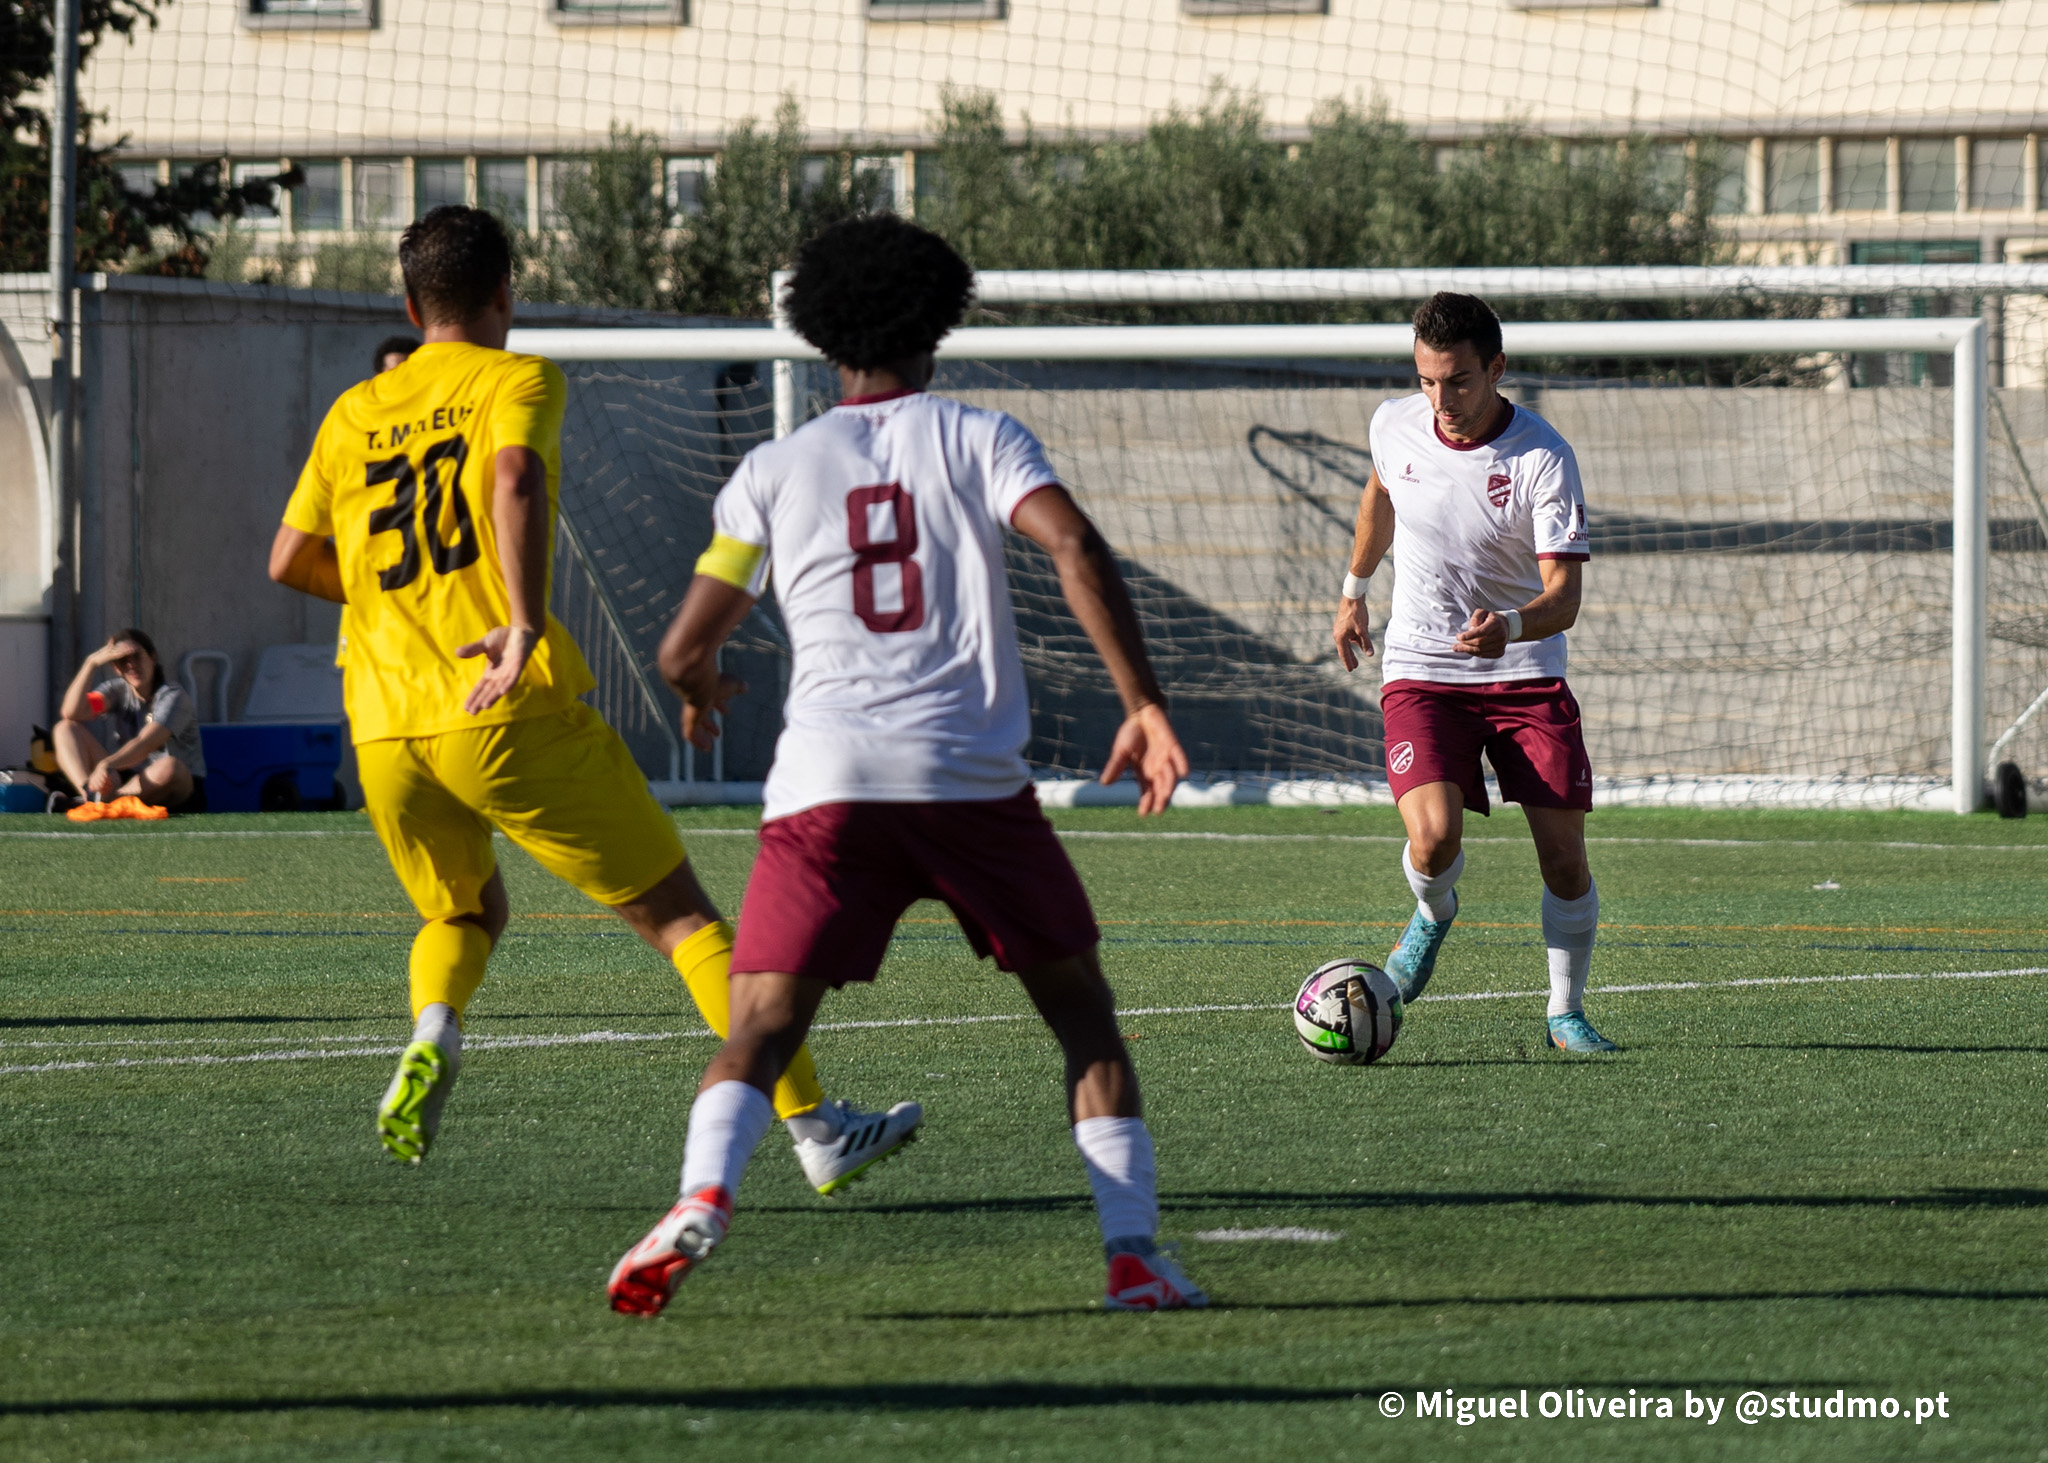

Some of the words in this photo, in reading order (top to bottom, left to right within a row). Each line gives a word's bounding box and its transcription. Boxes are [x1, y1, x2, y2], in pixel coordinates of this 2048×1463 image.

[365, 434, 481, 592] 30
[366, 429, 383, 450] T.
[846, 481, 925, 634] 8
